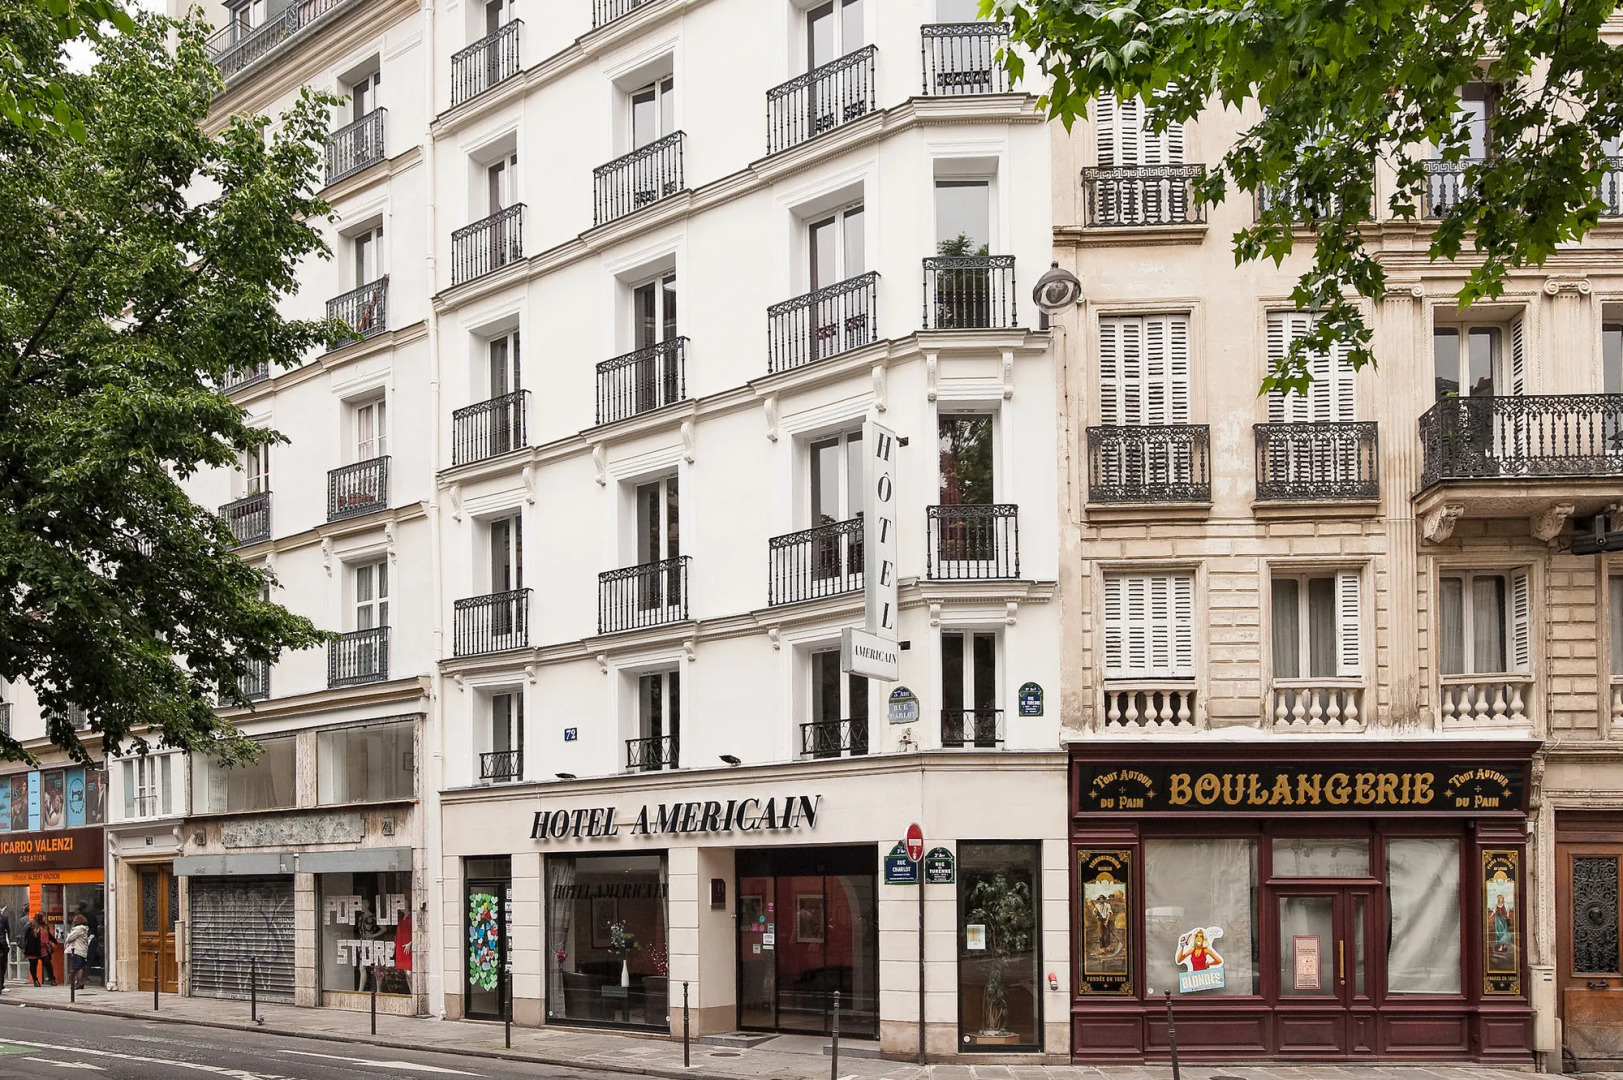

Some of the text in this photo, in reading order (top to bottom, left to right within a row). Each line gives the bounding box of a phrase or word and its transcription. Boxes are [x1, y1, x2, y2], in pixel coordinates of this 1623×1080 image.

[876, 432, 894, 631] HÔTEL
[852, 644, 897, 665] AMERICAIN
[893, 703, 909, 711] RUE
[1119, 769, 1154, 788] AUTOUR
[1476, 768, 1510, 787] AUTOUR
[1168, 772, 1435, 805] BOULANGERIE
[1100, 796, 1144, 809] DU PAIN
[1456, 795, 1499, 808] DU PAIN
[529, 795, 822, 839] HOTEL AMERICAIN
[35, 837, 74, 852] VALENZI
[20, 855, 47, 863] CREATION
[323, 893, 406, 926] POP UP
[336, 939, 396, 967] STORE
[1182, 972, 1222, 989] BLONDES
